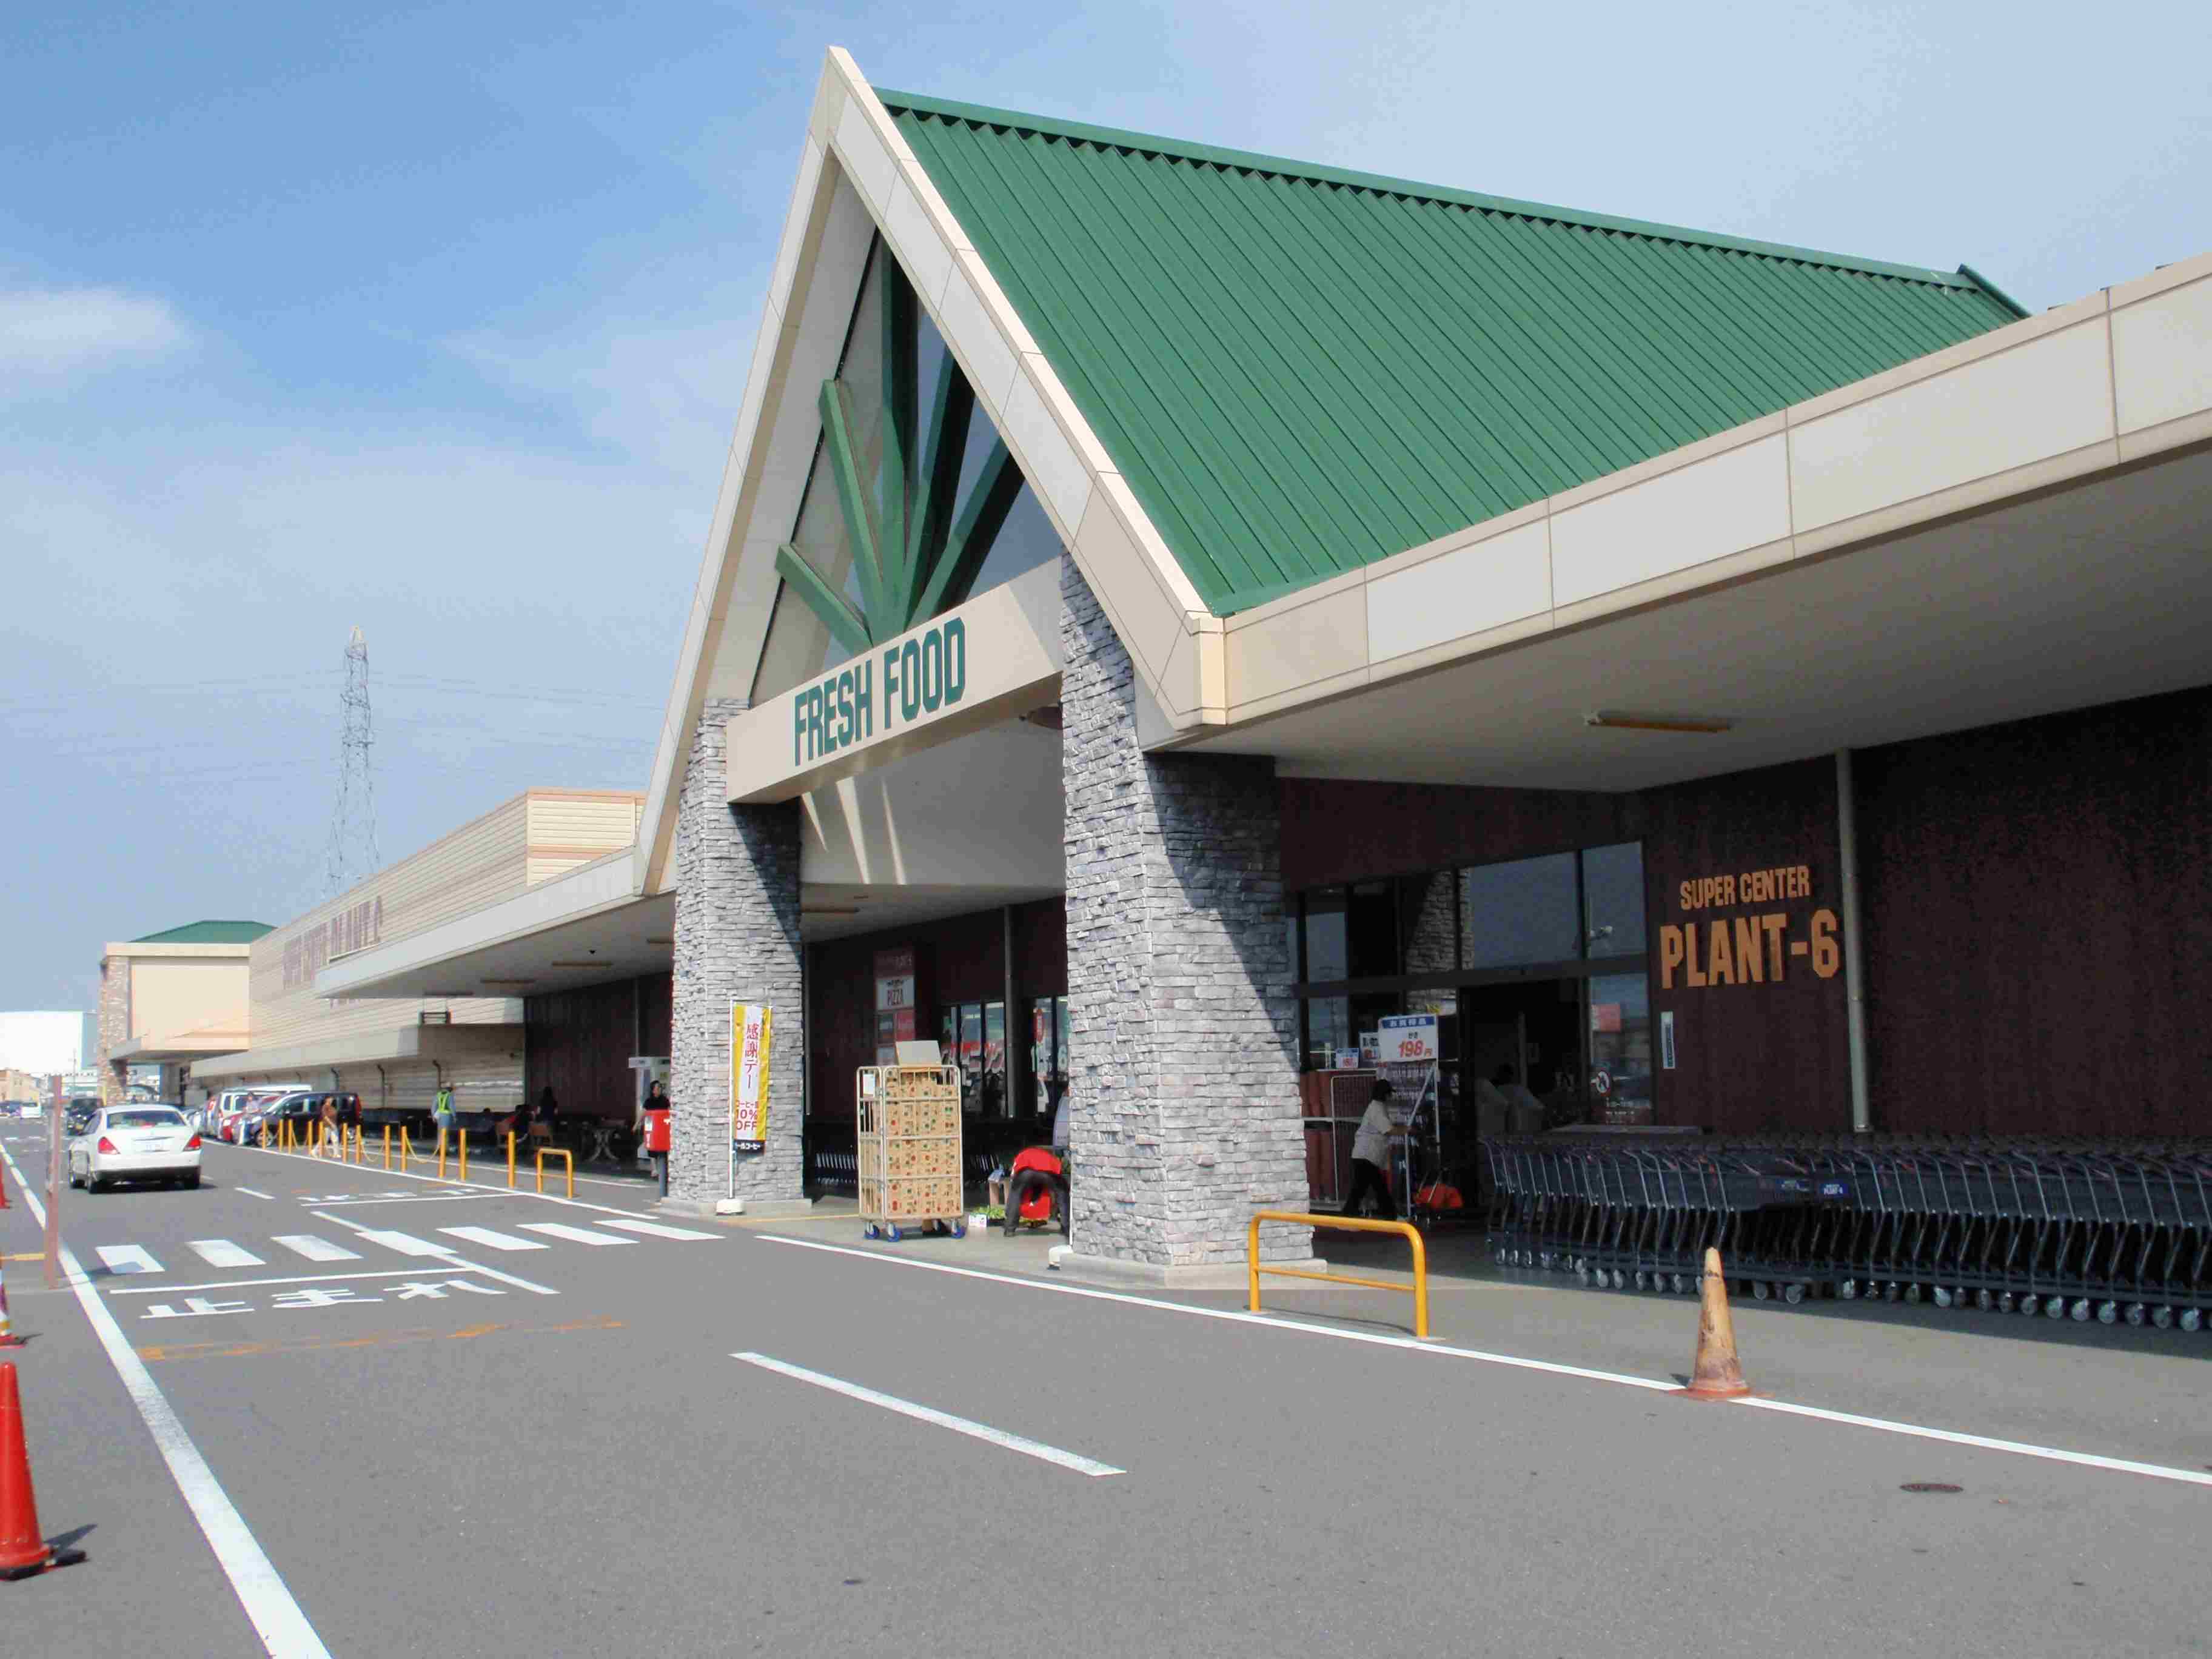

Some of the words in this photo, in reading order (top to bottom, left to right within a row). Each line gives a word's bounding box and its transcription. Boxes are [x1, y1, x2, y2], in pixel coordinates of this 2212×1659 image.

[795, 659, 873, 767] FRESH
[884, 616, 965, 730] FOOD
[1680, 874, 1735, 910] SUPER
[1740, 865, 1811, 902] CENTER
[1660, 909, 1839, 989] PLANT-6
[140, 1279, 508, 1318] 止まれ
